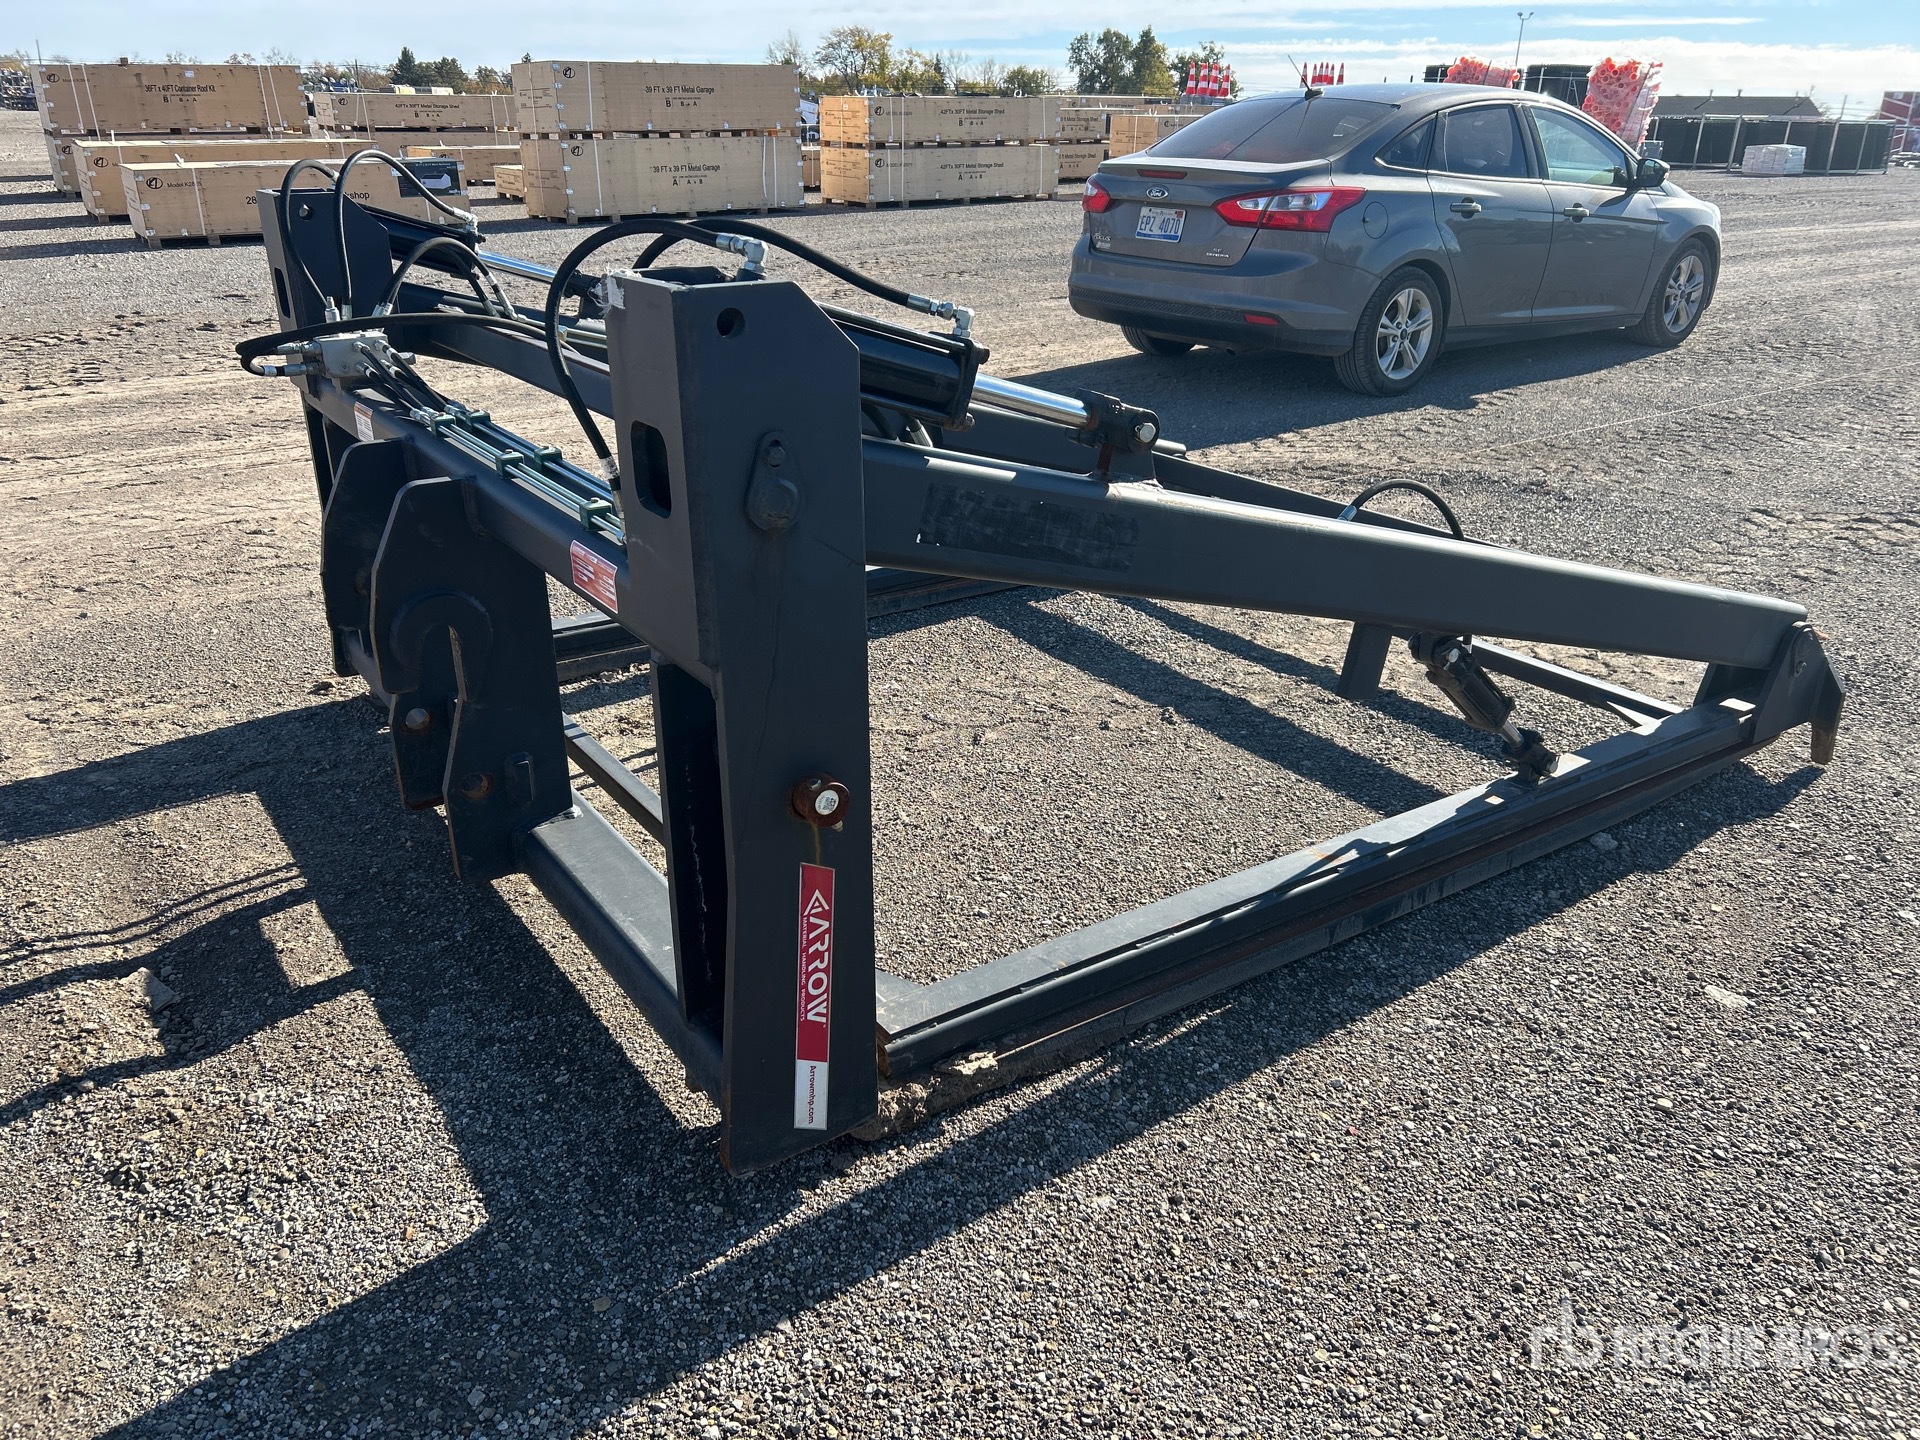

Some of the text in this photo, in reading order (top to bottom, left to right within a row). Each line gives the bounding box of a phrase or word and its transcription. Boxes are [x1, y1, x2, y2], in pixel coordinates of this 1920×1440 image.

[175, 84, 196, 92] Container
[681, 85, 695, 93] Metal
[696, 86, 714, 94] Garage
[702, 164, 720, 172] Garage
[1139, 215, 1180, 234] EPZ 4070
[807, 916, 830, 1022] ARROW
[808, 1066, 816, 1124] Arrowmhp.com
